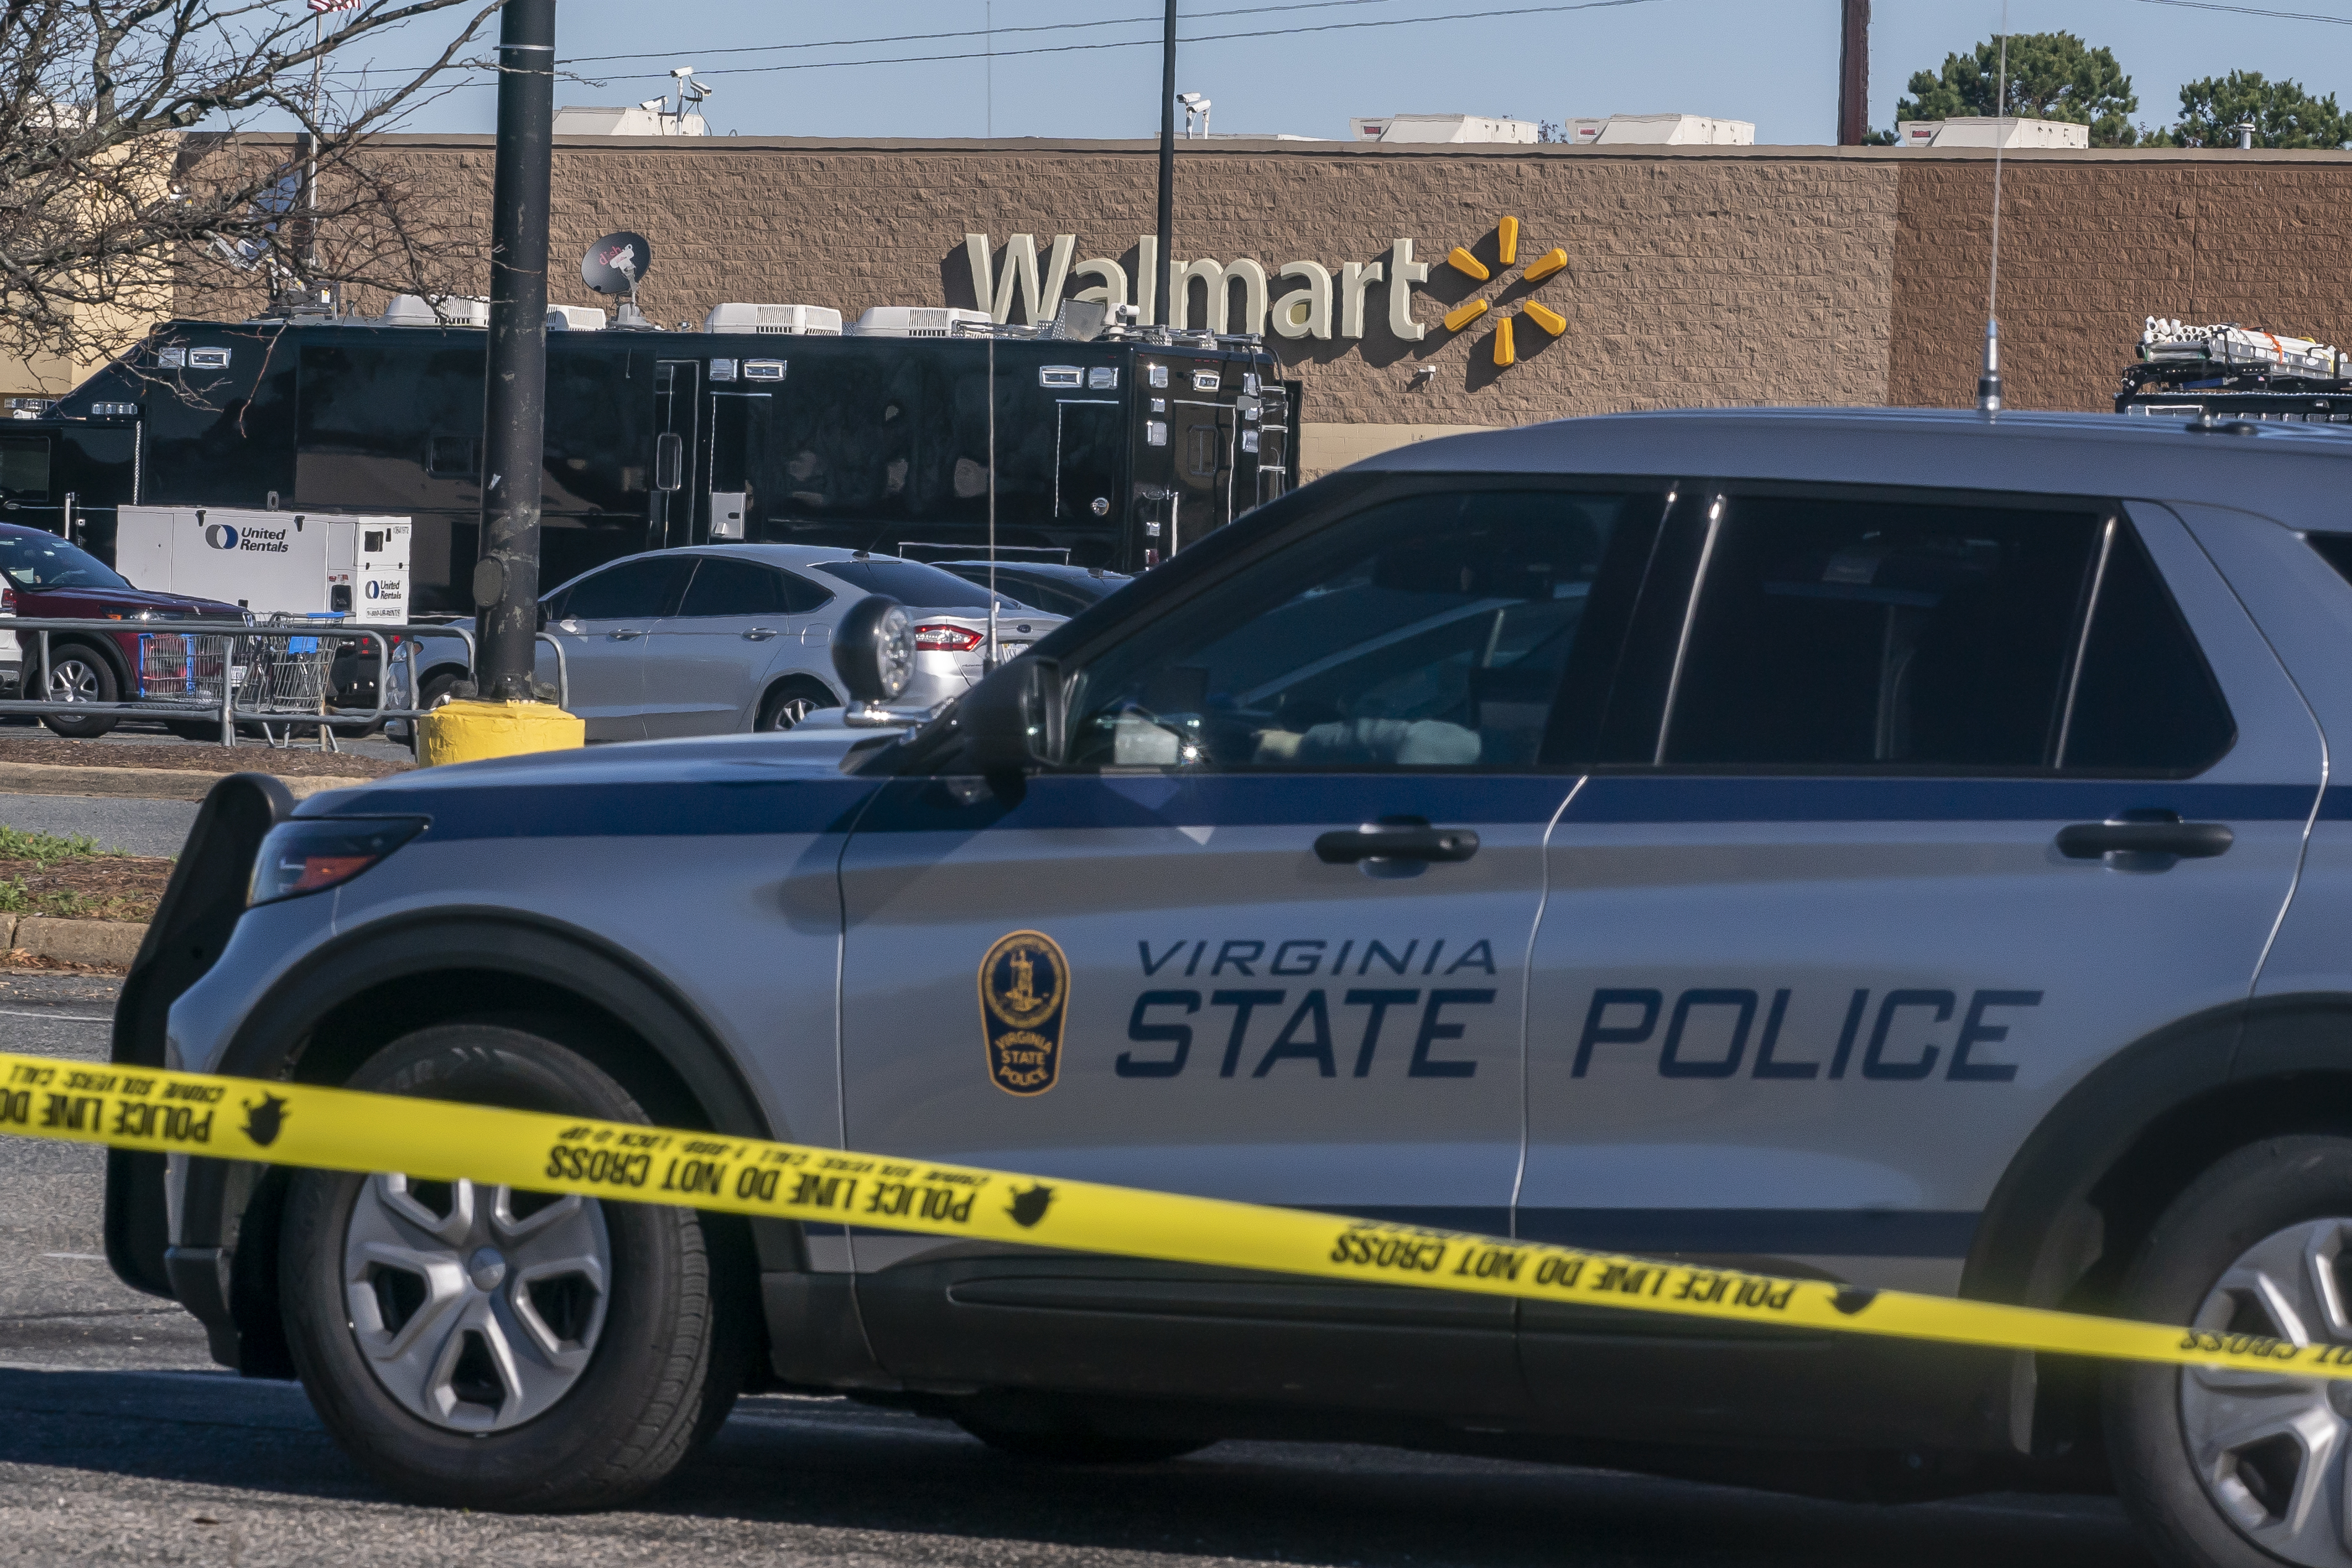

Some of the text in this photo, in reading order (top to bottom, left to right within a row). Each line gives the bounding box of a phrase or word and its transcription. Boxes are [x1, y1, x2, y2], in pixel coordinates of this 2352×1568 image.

[966, 233, 1428, 342] Walmart
[240, 539, 289, 553] Rentals
[241, 527, 287, 540] United
[380, 580, 400, 590] United
[380, 591, 402, 600] Rentals
[1137, 938, 1497, 977] VIRGINIA
[994, 1030, 1053, 1055] VIRGINIA
[1115, 987, 2046, 1081] STATE POLICE
[998, 1064, 1049, 1086] POLICE
[1000, 1050, 1046, 1065] STATE
[39, 1091, 104, 1133] LINE
[111, 1099, 215, 1143] POLICE
[545, 1144, 652, 1189] CROSS
[659, 1156, 729, 1197] NOT
[735, 1165, 780, 1202] DO
[787, 1172, 859, 1211] LINE
[865, 1182, 976, 1224] POLICE
[1330, 1232, 1447, 1273] CROSS
[1451, 1245, 1529, 1281] NOT
[1534, 1254, 1586, 1288] DO
[1590, 1264, 1671, 1297] LINE
[1671, 1272, 1797, 1312] POLICE
